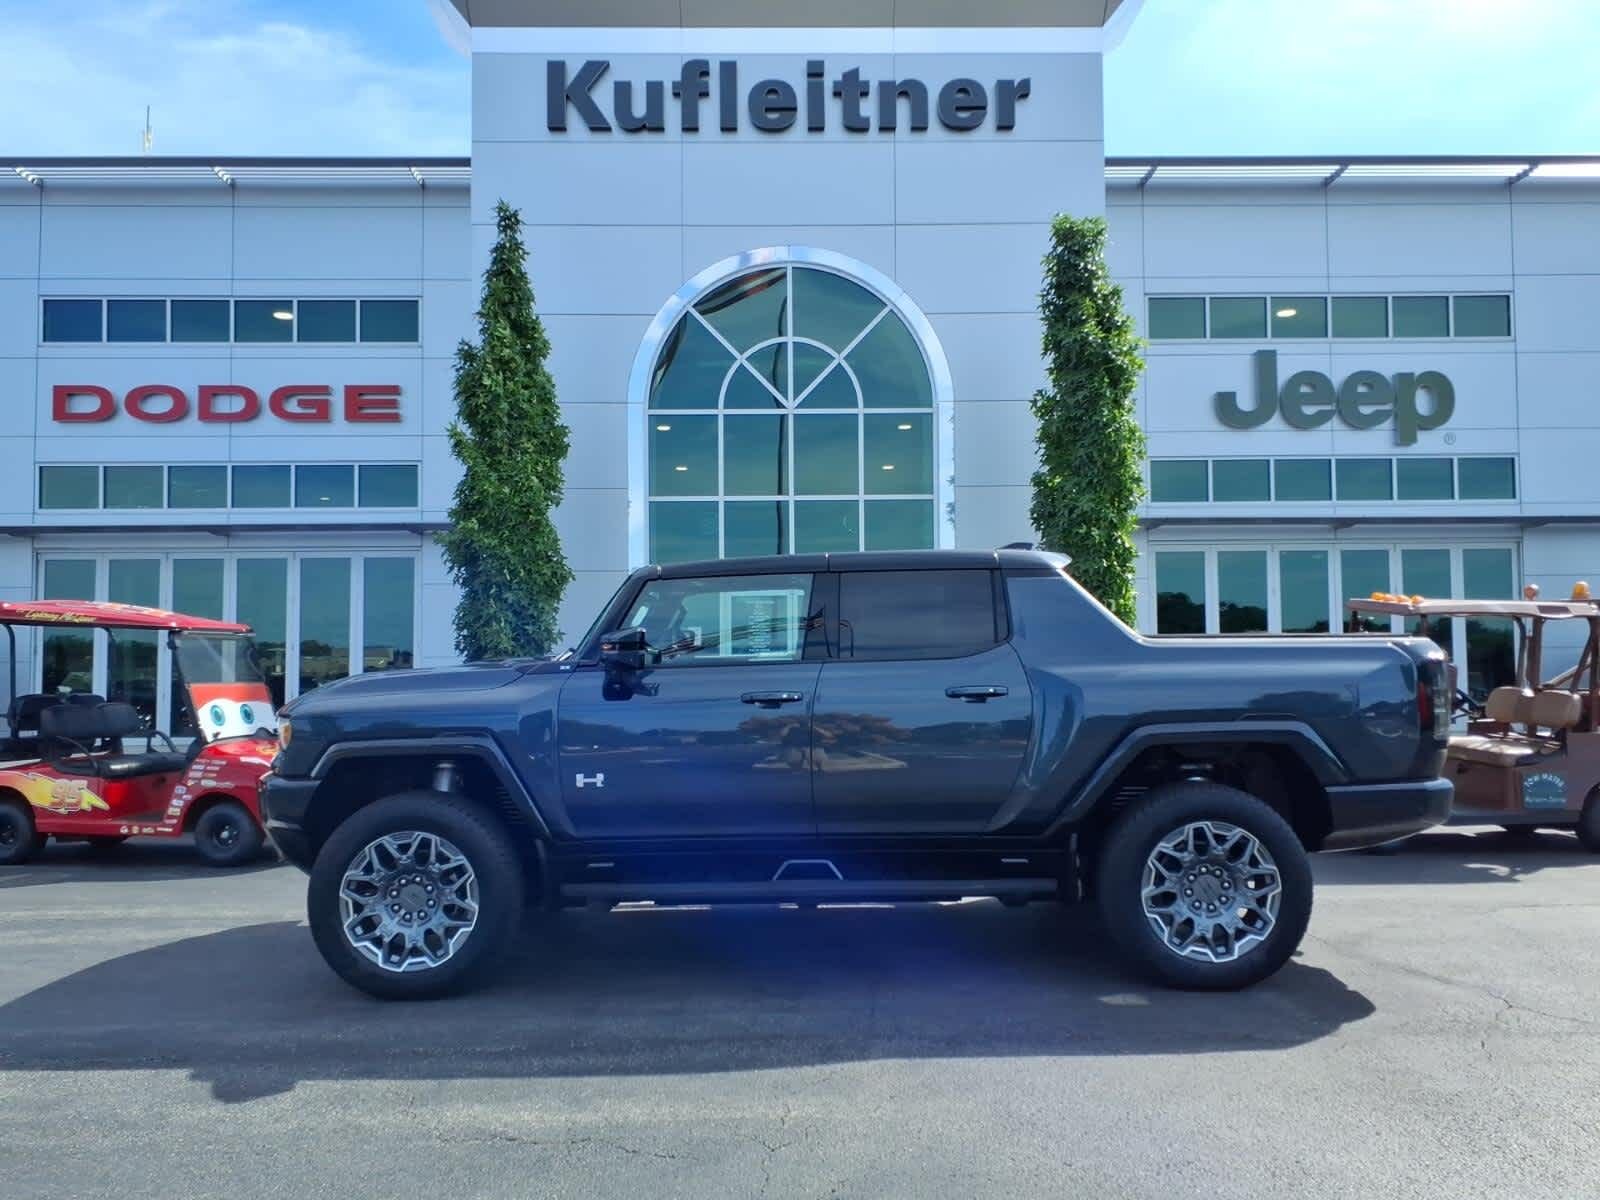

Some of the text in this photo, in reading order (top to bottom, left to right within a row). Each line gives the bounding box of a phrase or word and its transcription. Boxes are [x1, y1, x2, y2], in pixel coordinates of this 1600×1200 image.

[547, 59, 1031, 132] Kufleitner
[52, 384, 402, 423] DODGE
[1214, 349, 1455, 447] Jeep
